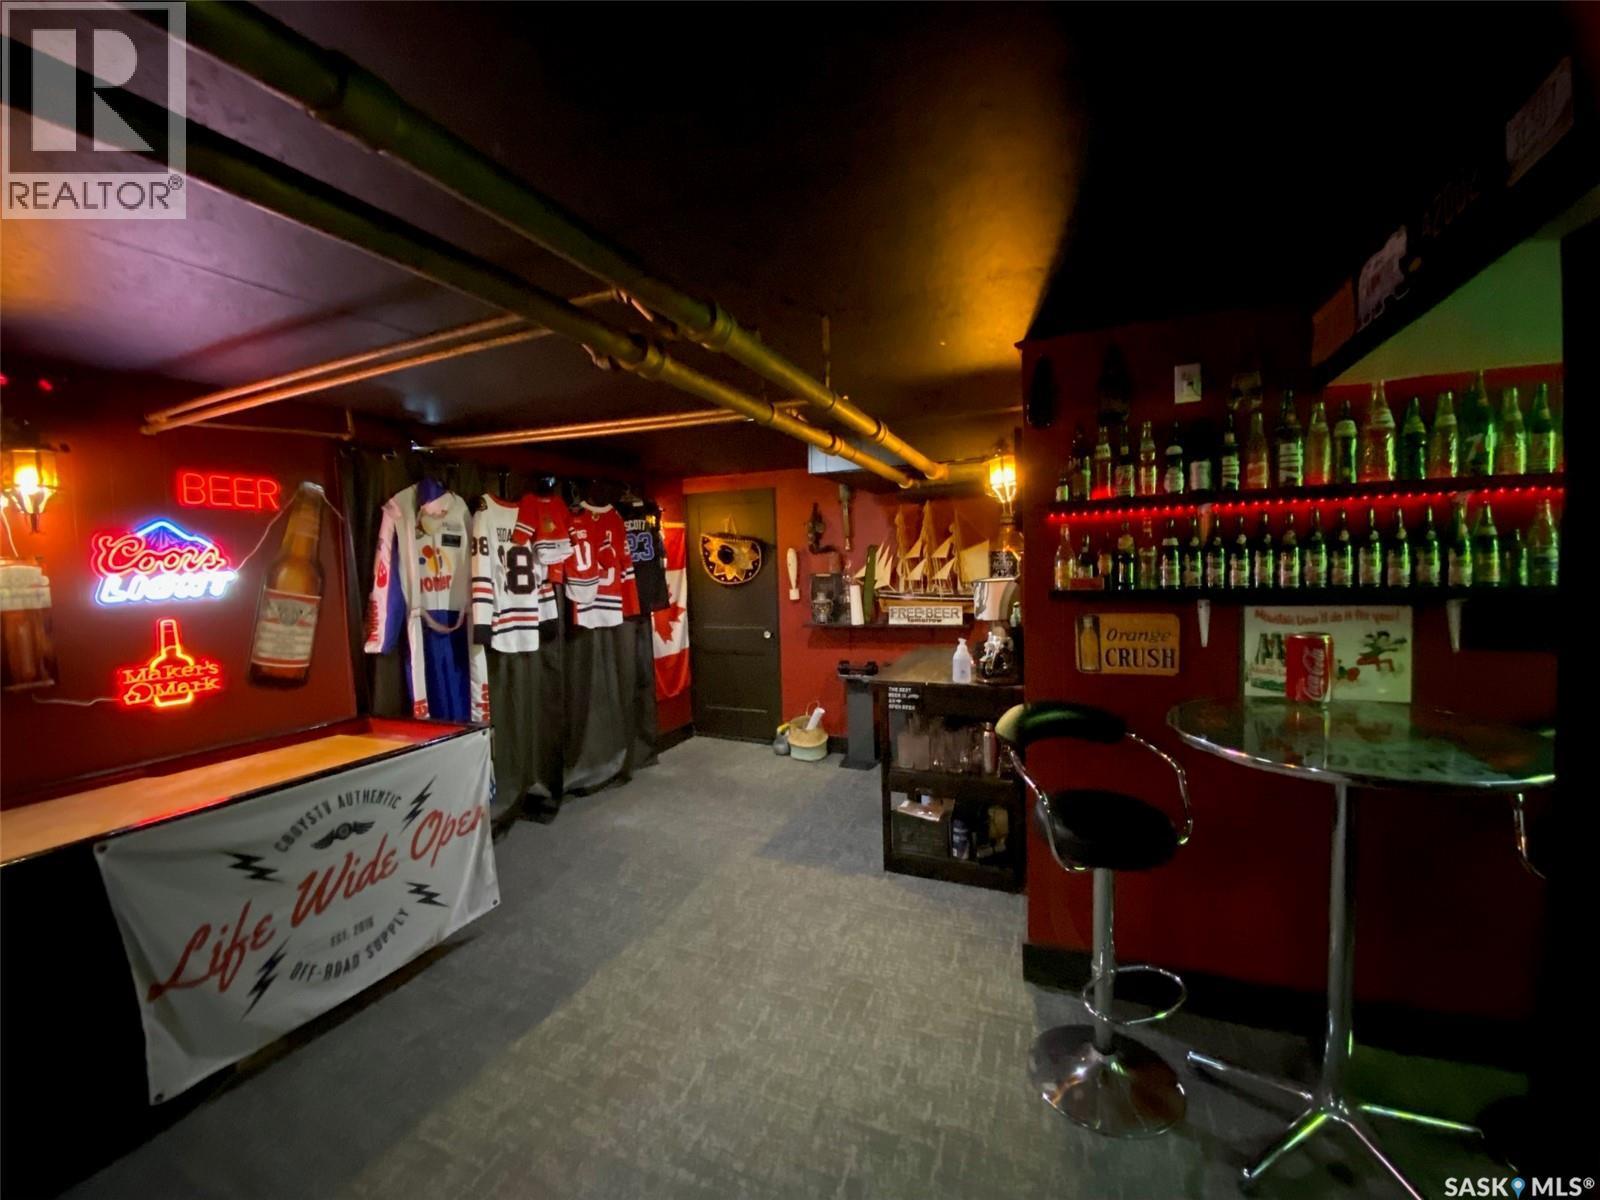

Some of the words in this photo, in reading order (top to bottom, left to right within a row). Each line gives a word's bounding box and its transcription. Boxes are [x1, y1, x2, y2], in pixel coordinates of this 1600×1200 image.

[181, 472, 280, 510] BEER
[624, 520, 647, 532] SCOTT
[97, 533, 228, 576] Coors
[890, 607, 922, 619] FREE
[926, 607, 960, 619] BEER
[1106, 627, 1172, 643] Orange
[1105, 648, 1176, 669] CRUSH
[123, 660, 220, 684] Maker's
[155, 676, 220, 698] Mark
[338, 789, 402, 810] AUTHENTIC
[146, 898, 277, 1004] Life
[290, 832, 399, 929] Wide
[289, 952, 360, 982] OFF-ROAD
[365, 907, 409, 959] SUPPLY
